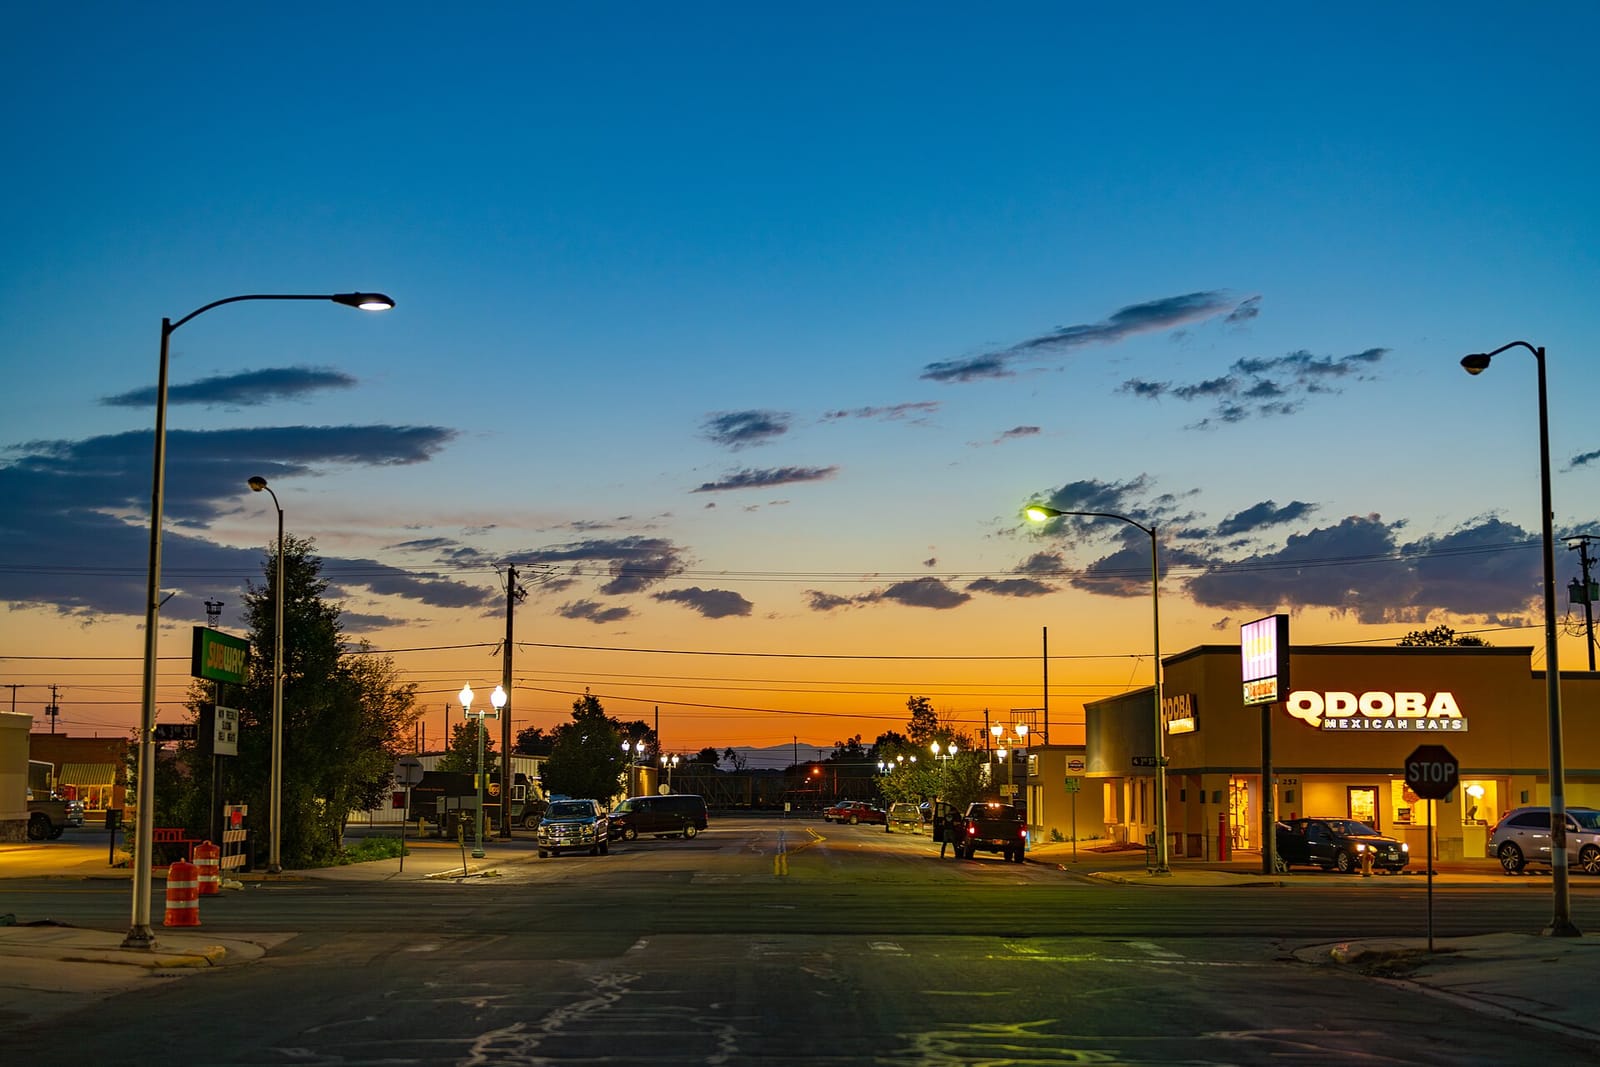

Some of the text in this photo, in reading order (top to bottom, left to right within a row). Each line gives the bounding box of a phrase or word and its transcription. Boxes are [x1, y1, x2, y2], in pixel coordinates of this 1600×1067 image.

[207, 641, 246, 674] SUBWAY
[1286, 690, 1463, 728] QDOBA
[1324, 719, 1463, 729] MEXICAN EATS
[1408, 762, 1455, 782] STOP
